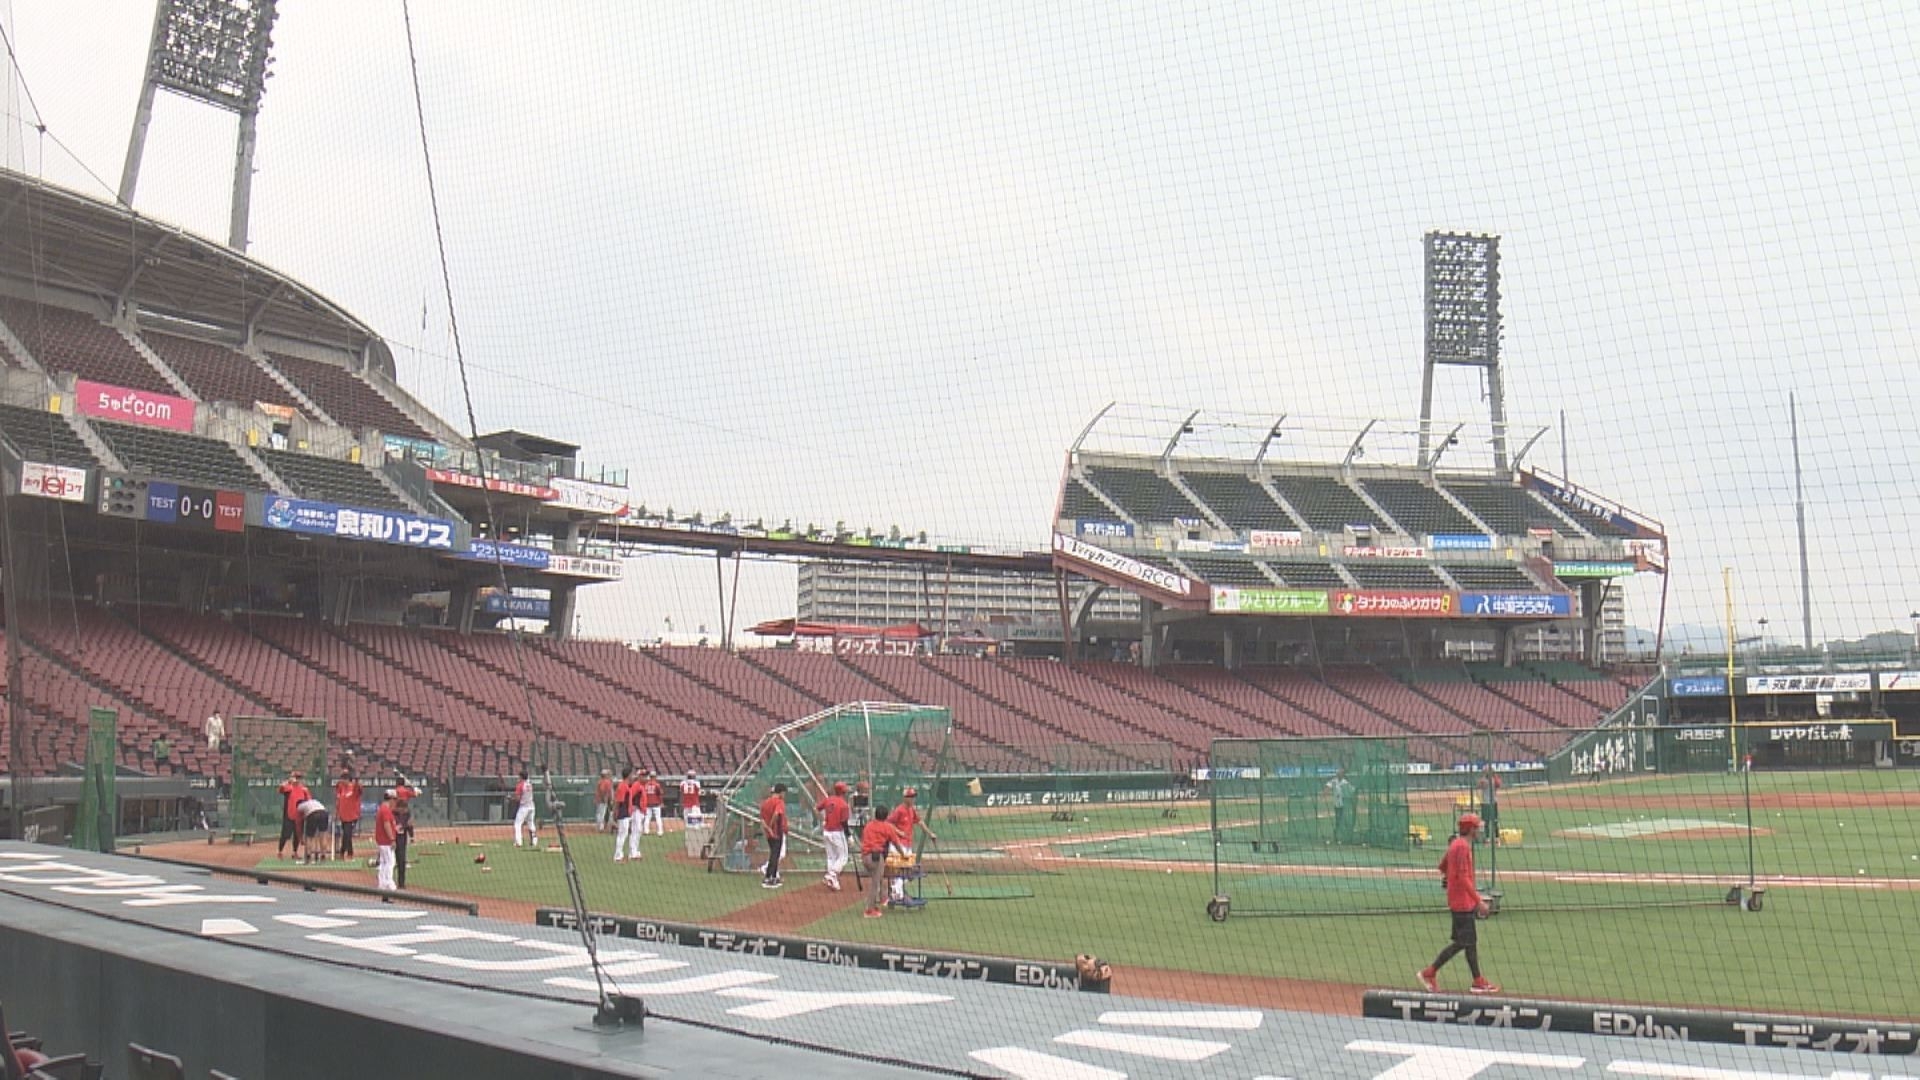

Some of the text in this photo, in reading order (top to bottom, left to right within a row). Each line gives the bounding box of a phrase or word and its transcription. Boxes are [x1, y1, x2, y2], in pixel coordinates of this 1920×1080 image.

[151, 496, 176, 509] TEST
[219, 504, 242, 519] TEST
[336, 509, 451, 548] 良和ハウス
[1357, 595, 1441, 611] タナカのふりかけ
[1492, 597, 1555, 614] 中国ろうきん
[1675, 728, 1726, 741] JR西日本
[1770, 725, 1853, 741] シマヤだしの素
[699, 931, 786, 960] エディオン
[882, 952, 988, 982] エディオン
[1391, 999, 1553, 1032] エディオン
